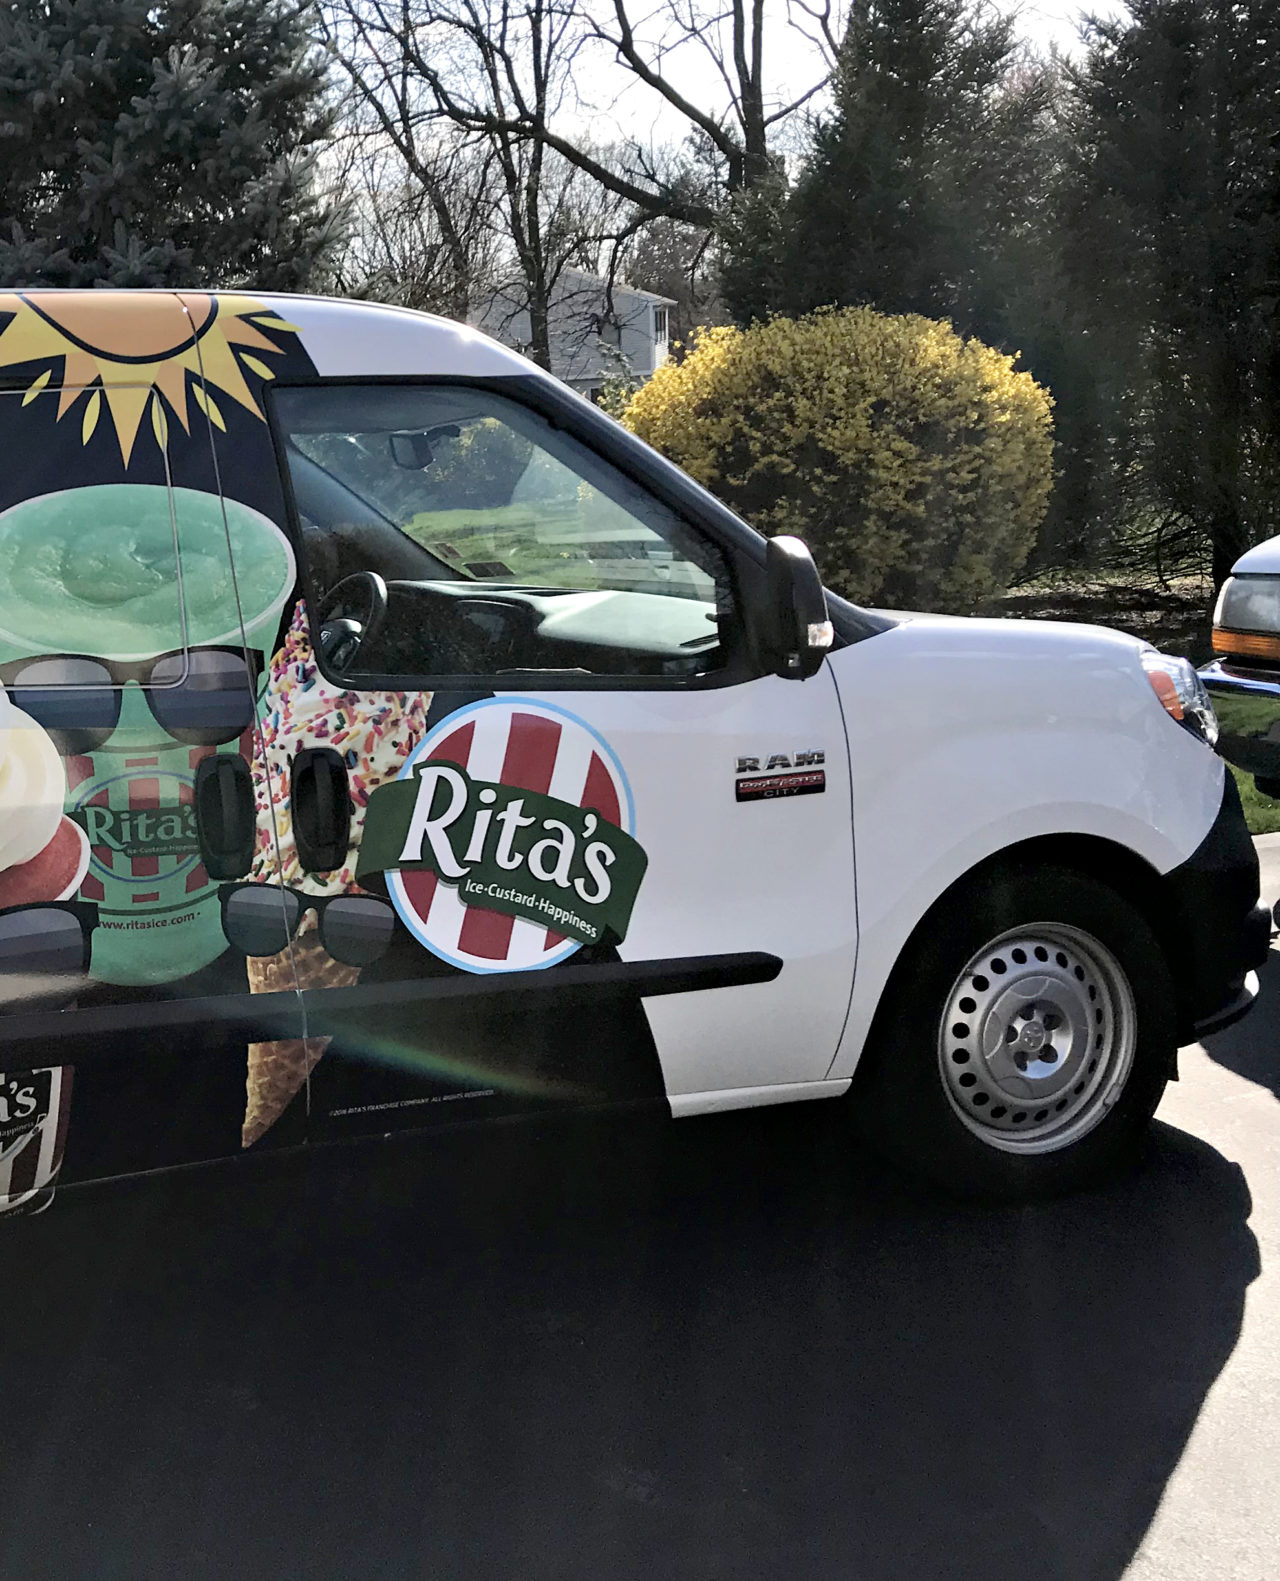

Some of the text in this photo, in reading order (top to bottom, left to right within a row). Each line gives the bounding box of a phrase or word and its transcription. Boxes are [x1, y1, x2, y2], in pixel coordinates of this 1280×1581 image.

[736, 749, 825, 773] RAM
[763, 787, 800, 797] CITY
[398, 766, 616, 904] Rita's
[100, 912, 194, 929] ww.ritasice.com
